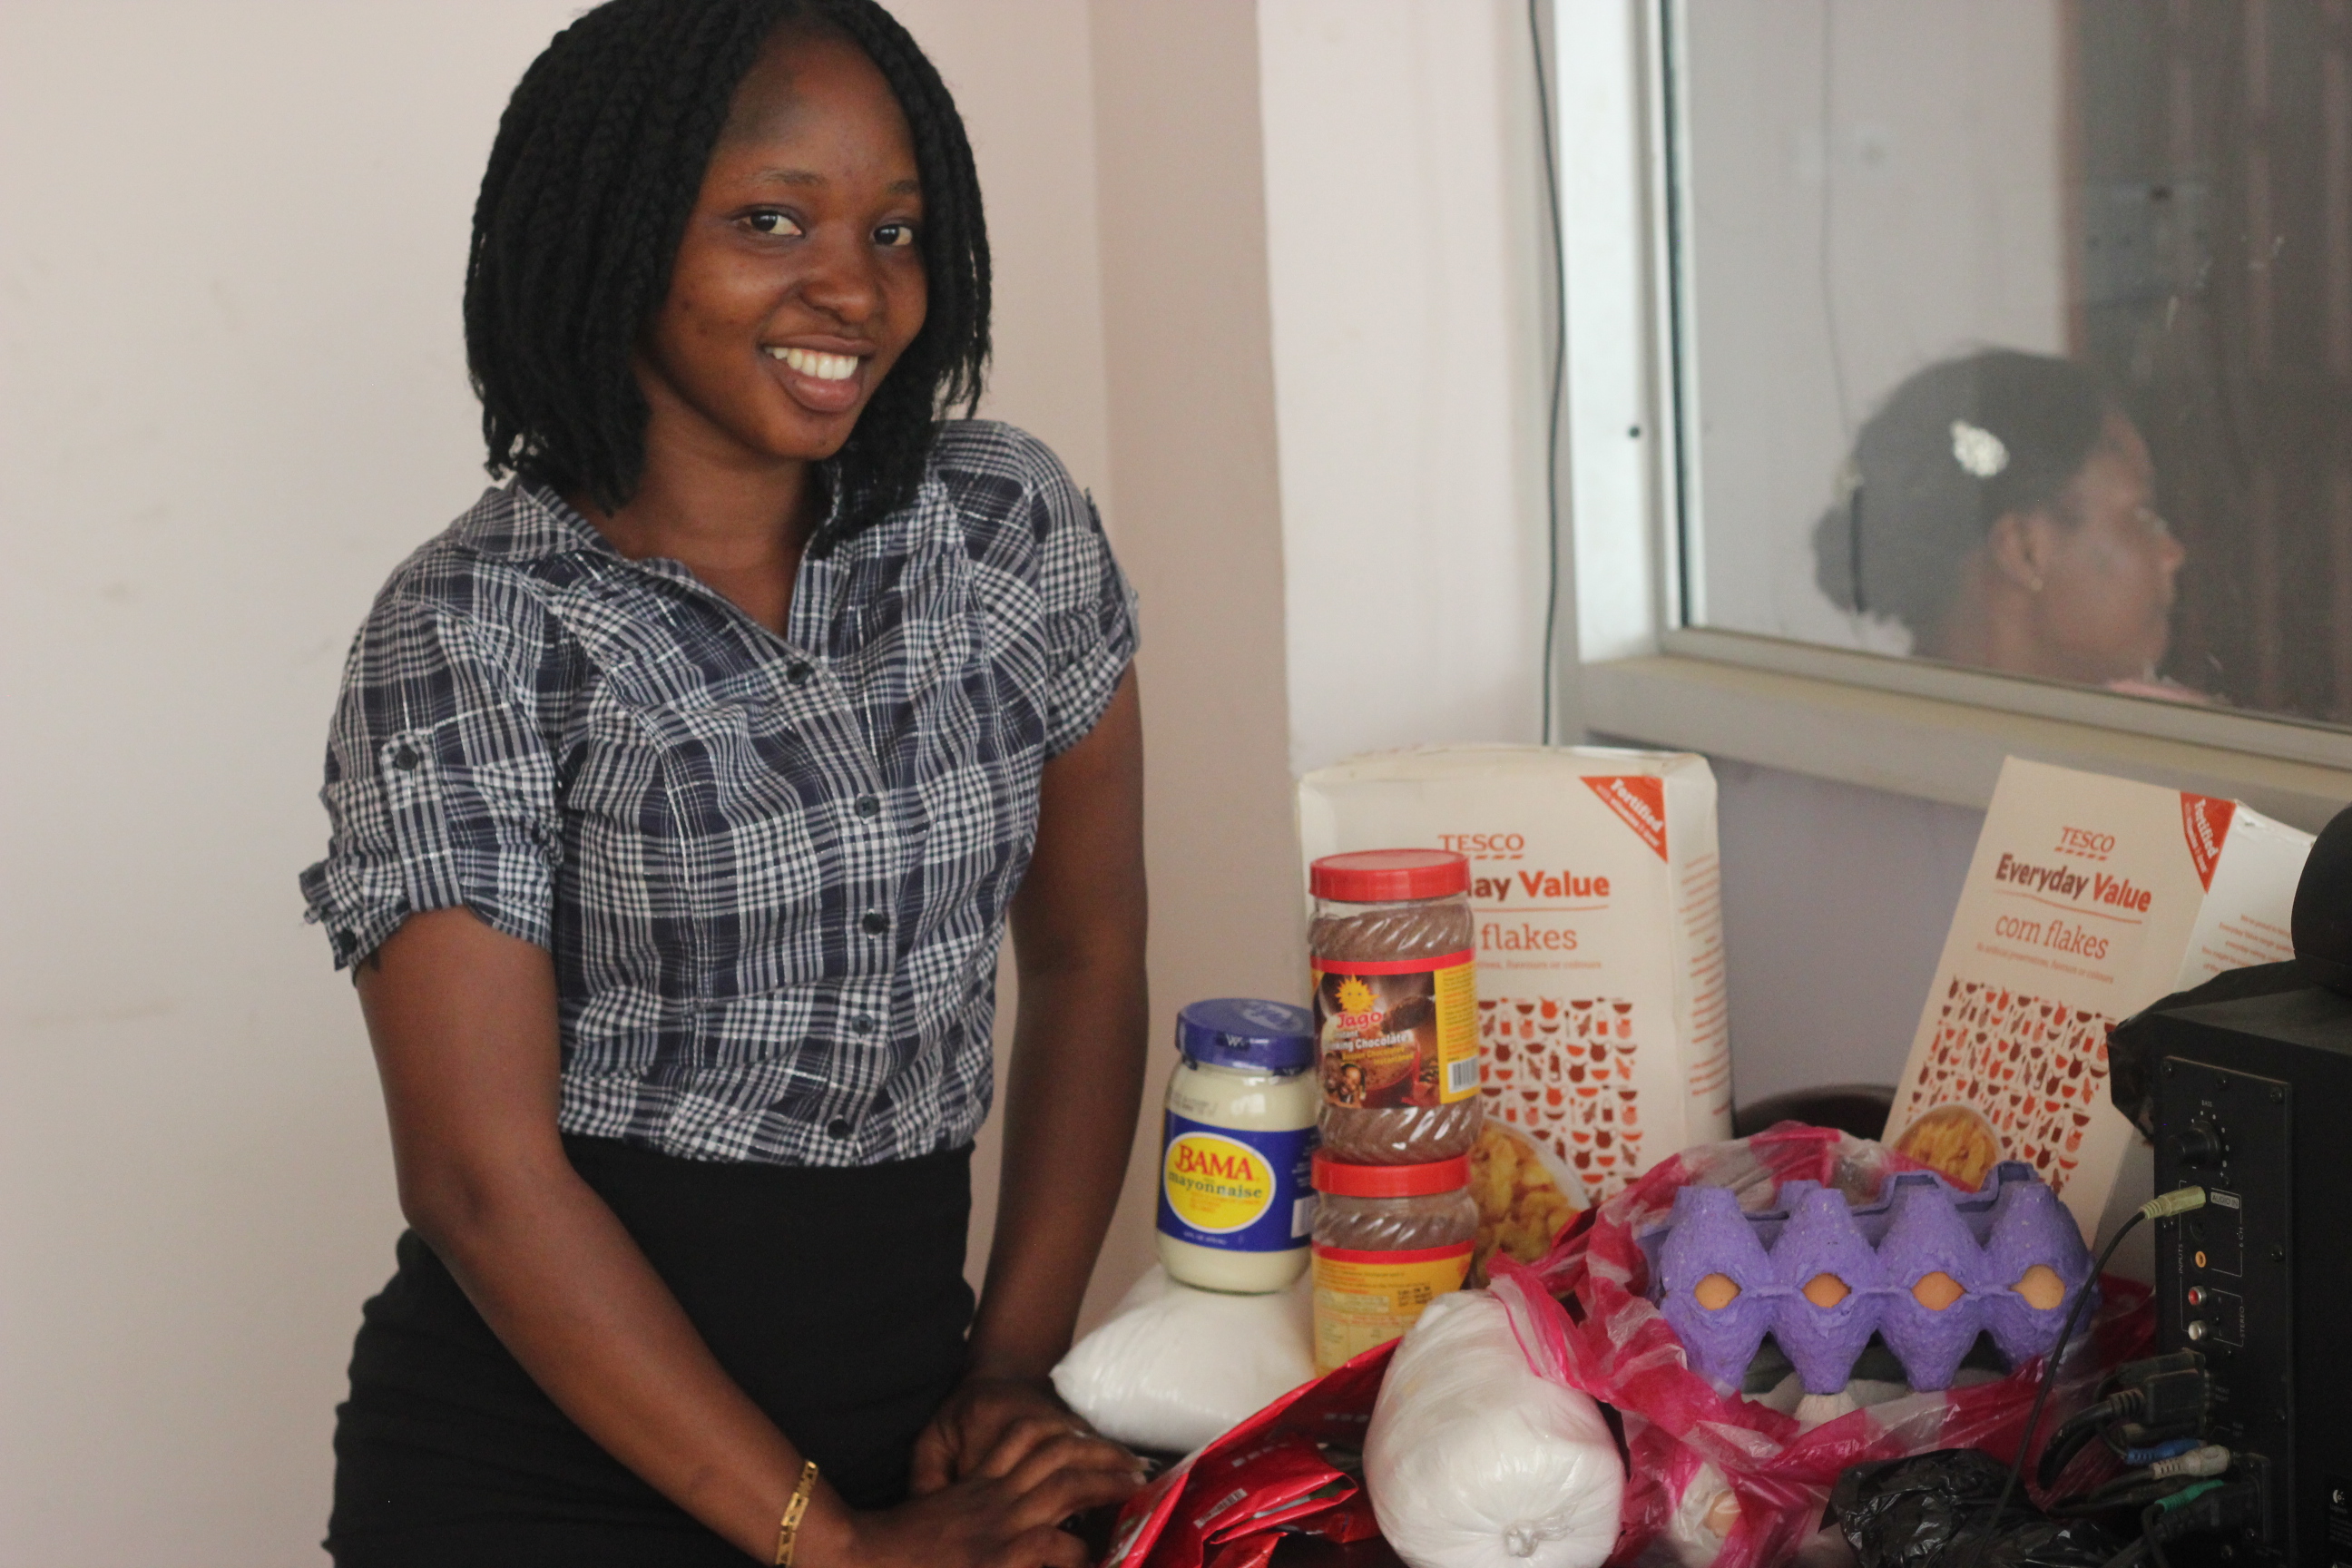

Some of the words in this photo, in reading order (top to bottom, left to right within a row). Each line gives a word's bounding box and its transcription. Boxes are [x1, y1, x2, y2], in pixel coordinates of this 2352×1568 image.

[1437, 832, 1524, 852] TESCO
[2060, 826, 2116, 854] TESCO
[1517, 869, 1611, 898] Value
[1995, 851, 2090, 900] Everyday
[2092, 871, 2152, 913] Value
[1481, 922, 1578, 951] flakes
[1994, 915, 2042, 944] corn
[2043, 918, 2110, 960] flakes
[1337, 1011, 1383, 1029] Jago
[1174, 1144, 1253, 1181] BAMA
[1168, 1171, 1263, 1199] mayonnaise
[2211, 1195, 2230, 1205] AUDIO
